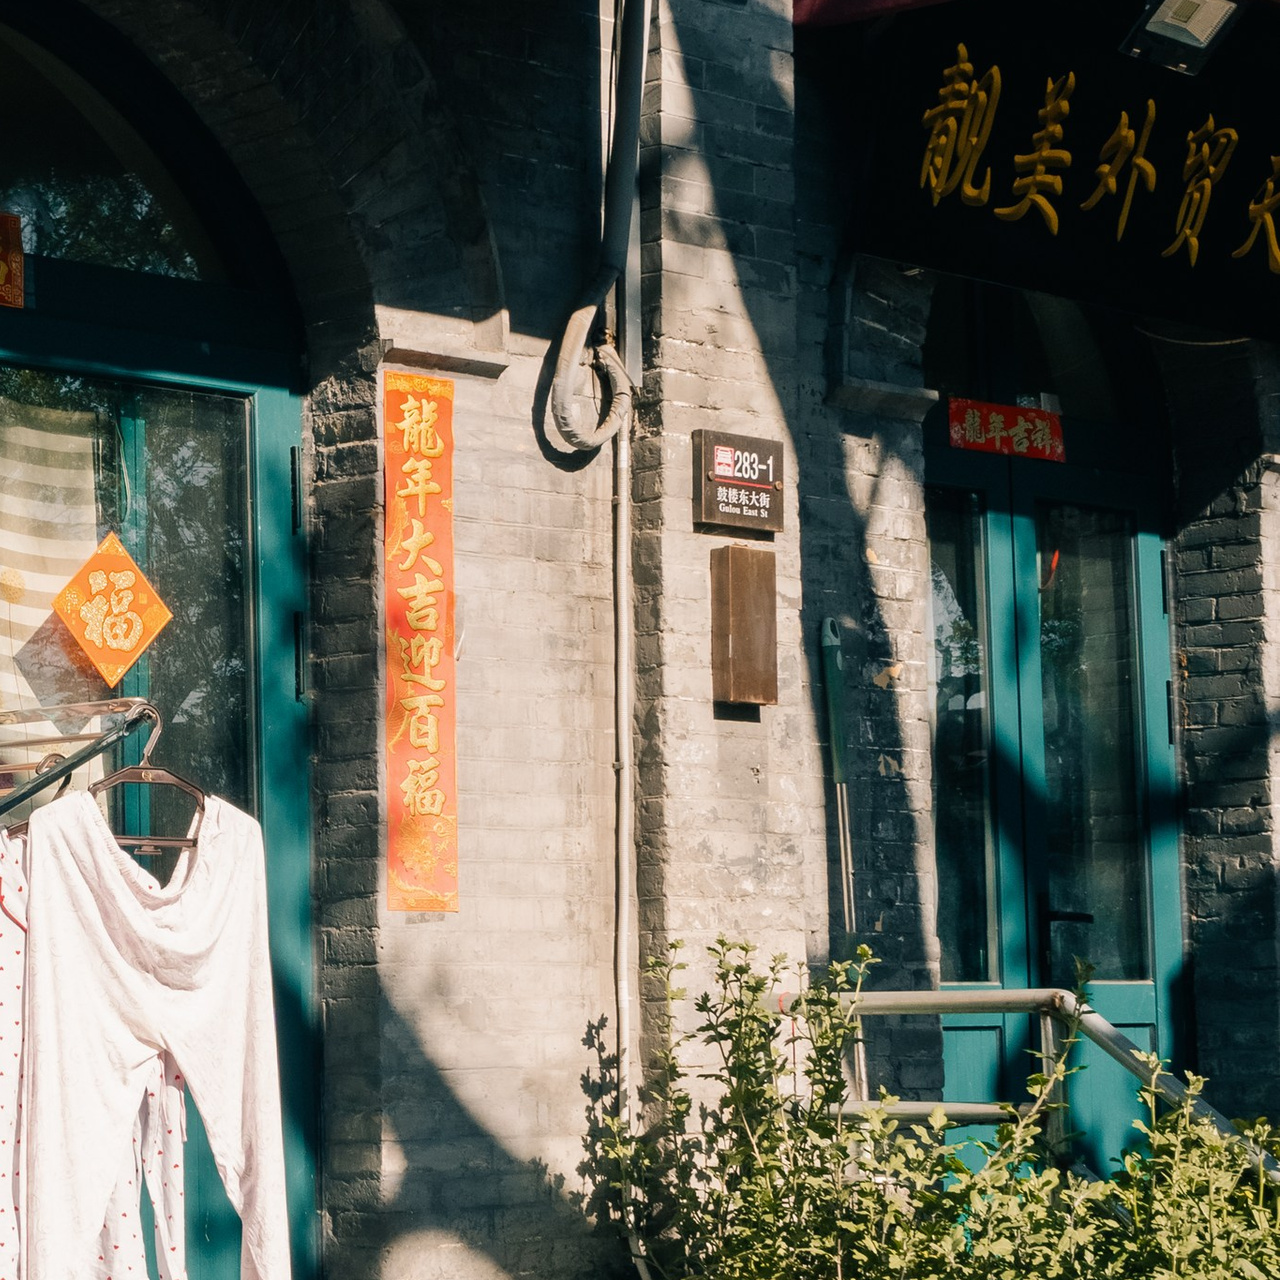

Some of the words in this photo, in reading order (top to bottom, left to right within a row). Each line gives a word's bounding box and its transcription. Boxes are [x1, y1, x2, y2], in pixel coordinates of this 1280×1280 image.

[962, 408, 1053, 455] 龍年吉祥
[734, 450, 773, 482] 283-1
[716, 486, 770, 509] 鼓楼东大街
[719, 503, 740, 515] Gulou
[743, 506, 758, 517] East
[79, 569, 144, 653] 福
[394, 394, 447, 817] 龍年大吉迎百福
